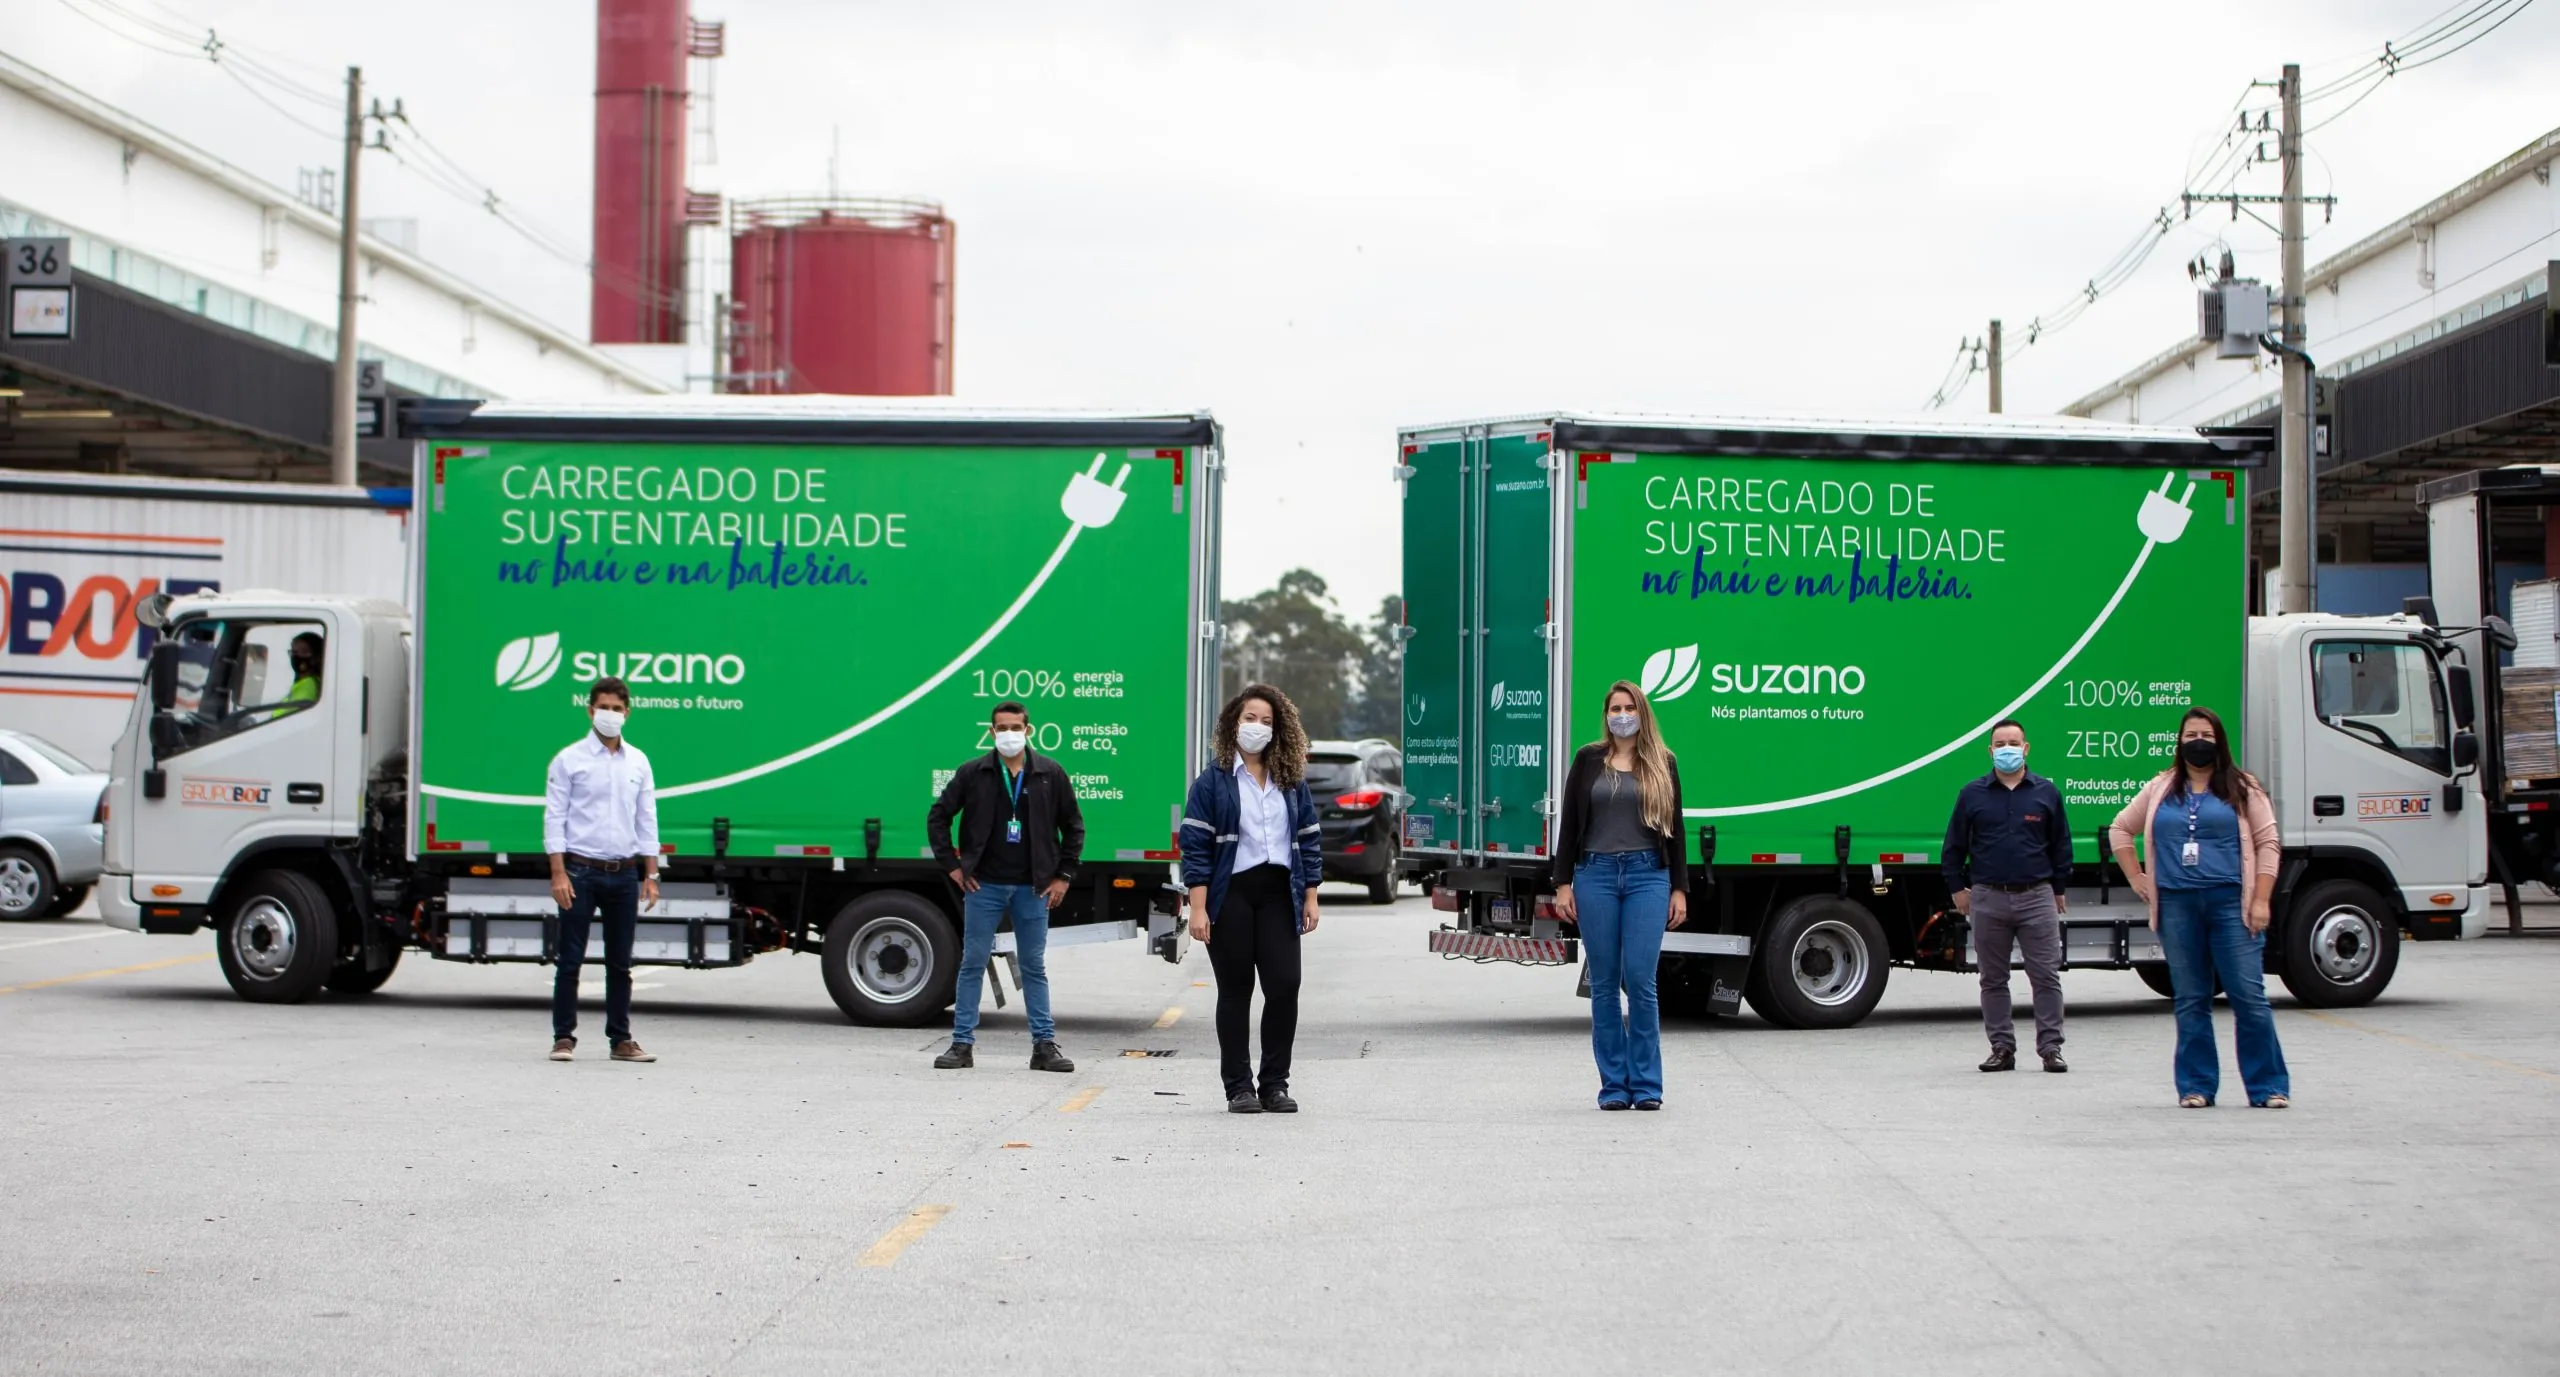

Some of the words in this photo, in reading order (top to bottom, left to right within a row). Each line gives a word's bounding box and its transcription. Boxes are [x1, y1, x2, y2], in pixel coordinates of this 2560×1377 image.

[18, 244, 58, 275] 36
[360, 365, 376, 390] 5
[502, 465, 757, 502] CARREGADO
[773, 468, 826, 502] DE
[1495, 478, 1545, 493] www.suzano.com.br
[1645, 475, 1873, 515] CARREGADO
[1889, 484, 1935, 517] DE
[501, 509, 907, 548] SUSTENTABILIDADE
[1645, 520, 2005, 562] SUSTENTABILIDADE
[498, 558, 545, 584] no
[552, 533, 628, 589] baú
[634, 560, 660, 585] e
[666, 560, 723, 585] na
[727, 537, 869, 592] bateria.
[1641, 569, 1686, 595] no
[1691, 545, 1760, 601] baú
[1765, 572, 1789, 597] e
[1795, 573, 1844, 597] na
[1849, 548, 1972, 604] bateria.
[572, 651, 745, 685] suzano
[972, 669, 1066, 698] 100%
[1073, 670, 1124, 685] energia
[1711, 663, 1865, 695] suzano
[1073, 685, 1124, 698] elétrica
[2063, 680, 2143, 707] 100%
[2148, 680, 2192, 693] energia
[572, 693, 591, 707] Nó
[629, 695, 680, 709] ntamos
[683, 698, 692, 709] o
[696, 695, 743, 710] futuro
[1506, 690, 1542, 706] suzano
[2148, 694, 2192, 706] elétrica
[1711, 705, 1735, 719] Nós
[1739, 706, 1808, 721] plantamos
[1811, 709, 1819, 719] o
[1822, 706, 1864, 720] futuro
[976, 722, 1062, 751] ZRO
[1072, 723, 1128, 736] emissão
[1072, 738, 1089, 750] de
[1406, 736, 1420, 748] Como
[1421, 738, 1435, 748] estou
[2067, 731, 2140, 758] ZERO
[2148, 745, 2162, 757] de
[1406, 752, 1418, 764] Com
[1419, 752, 1438, 767] energia
[1070, 772, 1109, 788] rigem
[2066, 778, 2119, 790] Produtos
[2122, 778, 2136, 789] de
[1075, 787, 1124, 800] icláveis
[2066, 792, 2121, 805] renovável
[2124, 794, 2131, 804] e
